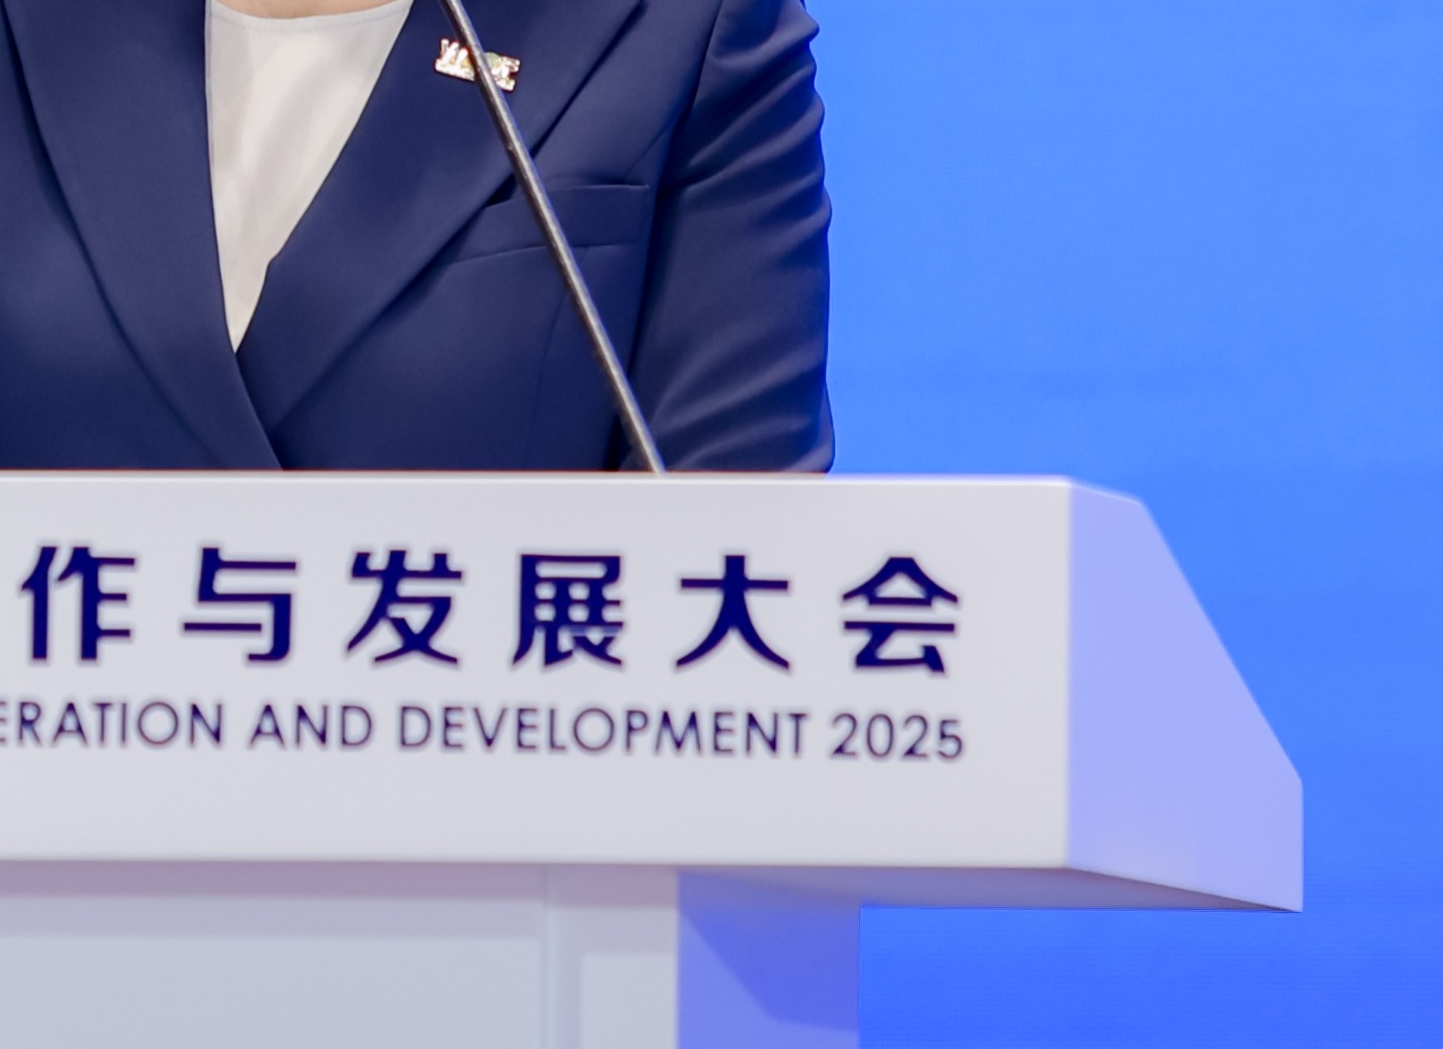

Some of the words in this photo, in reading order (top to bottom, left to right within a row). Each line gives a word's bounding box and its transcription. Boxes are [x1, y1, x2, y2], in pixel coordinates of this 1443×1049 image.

[250, 704, 373, 748] AND
[399, 705, 807, 756] DEVELOPMENT
[831, 712, 964, 760] 2025
